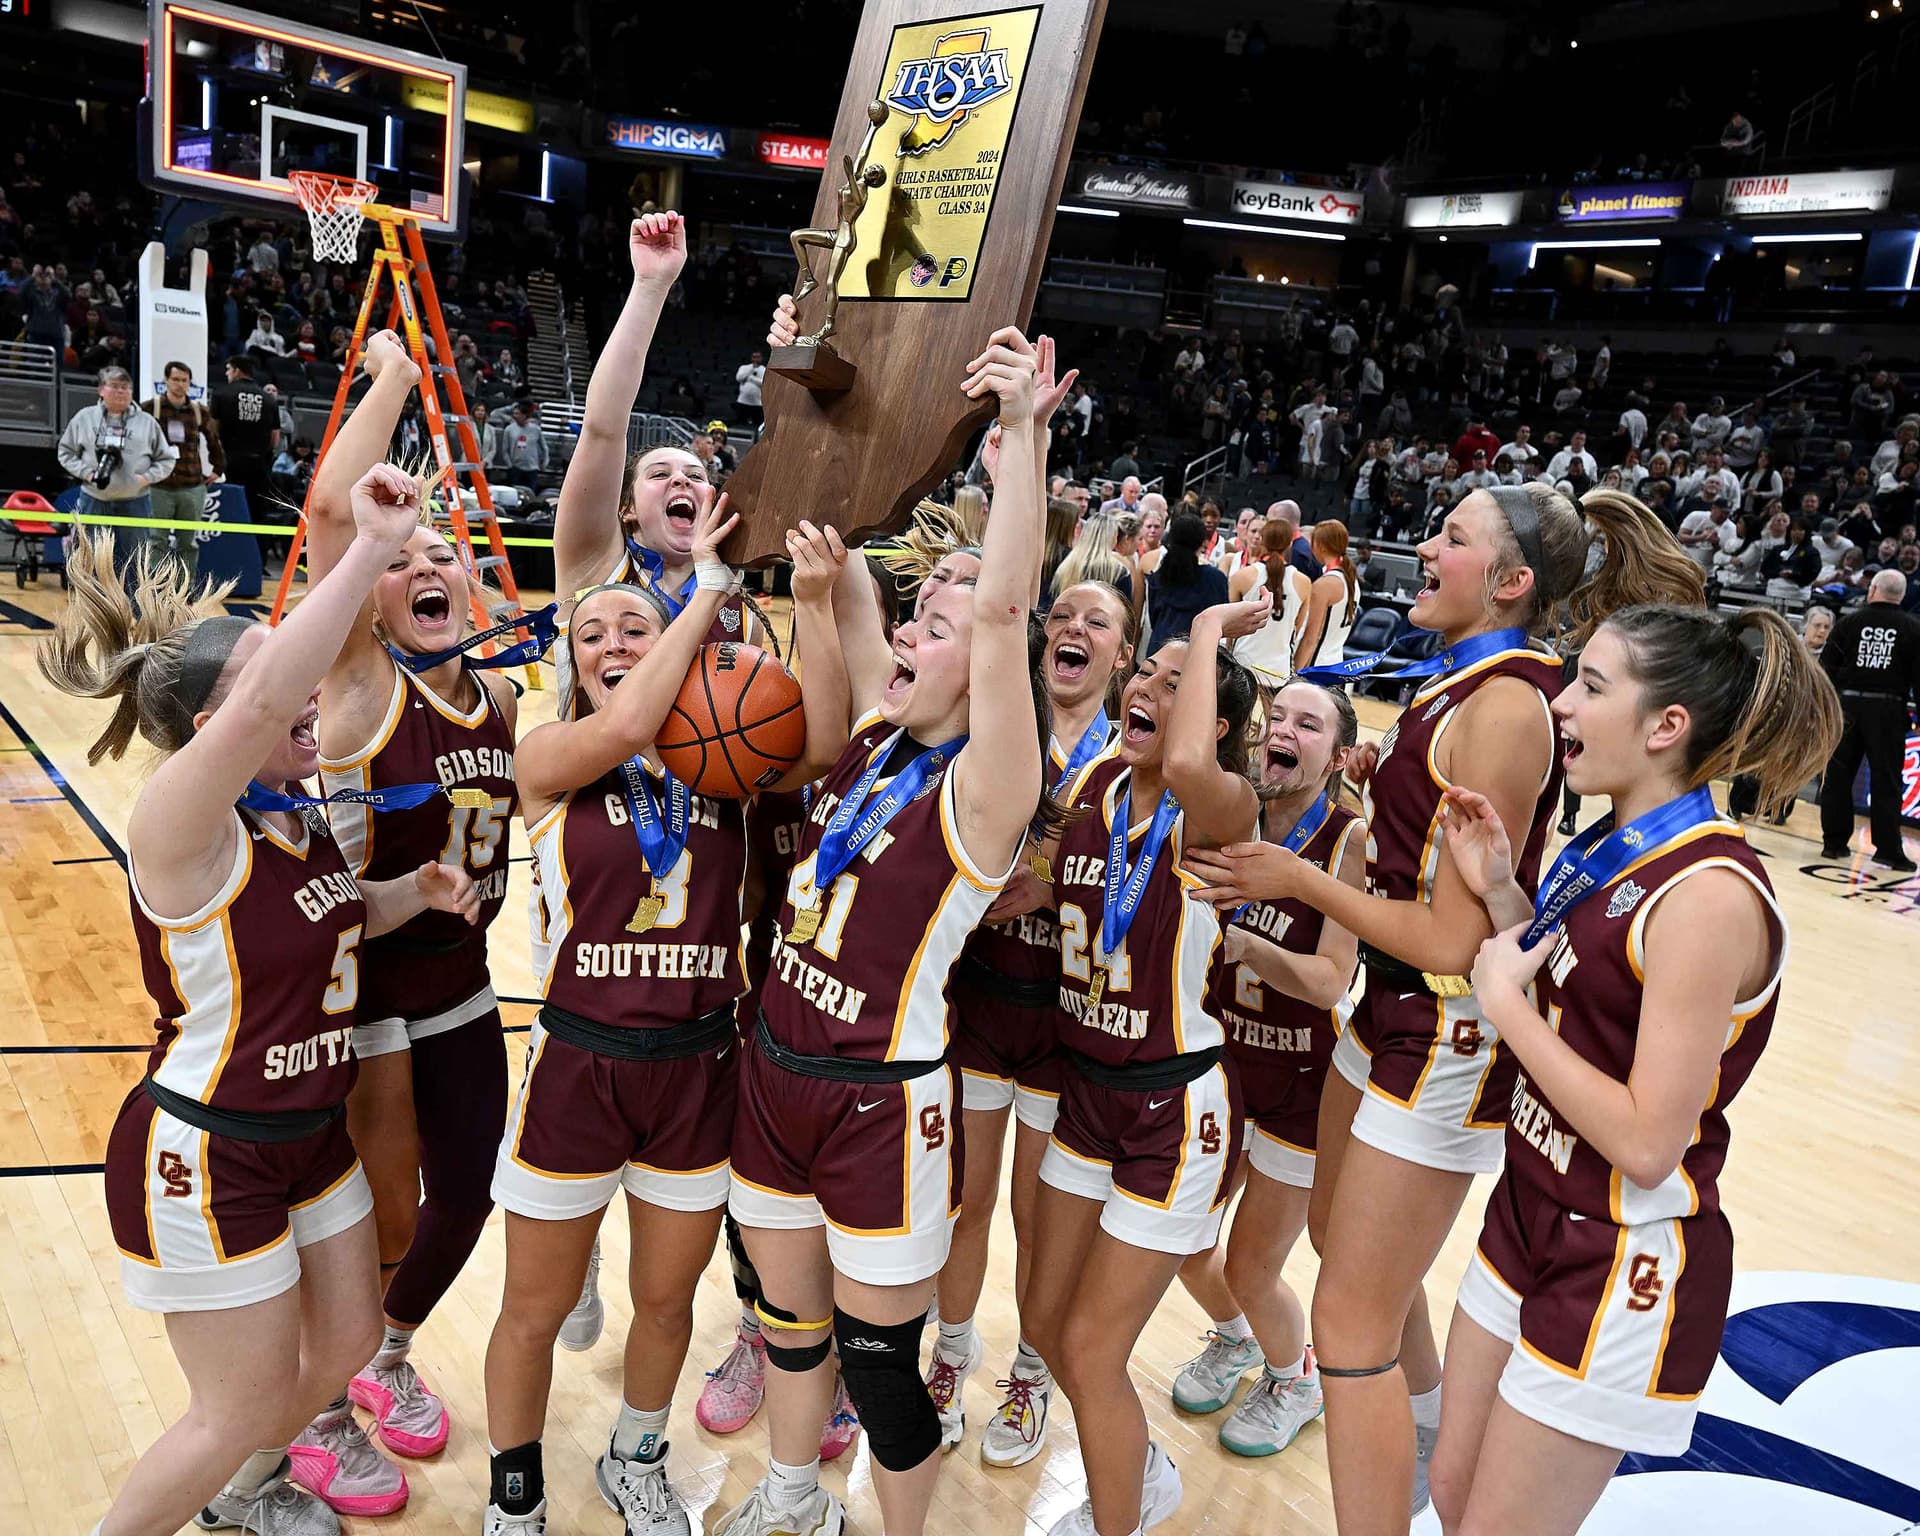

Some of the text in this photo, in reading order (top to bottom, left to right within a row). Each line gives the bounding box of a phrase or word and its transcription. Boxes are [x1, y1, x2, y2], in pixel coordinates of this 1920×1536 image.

[890, 54, 1008, 111] IHSAA
[607, 121, 725, 152] SHIPSIGMA
[762, 141, 811, 160] STEAK
[976, 150, 999, 163] 2024
[896, 167, 994, 184] GIRLS BASKETBALL
[902, 184, 991, 200] STATE CHAMPION
[1728, 177, 1789, 197] INDIANA
[938, 201, 985, 215] CLASS 3A
[1234, 189, 1315, 212] KeyBank
[1580, 194, 1684, 215] planet fitness
[1858, 640, 1894, 656] EVENT
[1861, 626, 1897, 642] CSC
[1856, 654, 1892, 669] STAFF
[623, 761, 653, 830] BASKETBALL
[671, 777, 685, 834] CHAMPION
[829, 767, 877, 835] BASKETBALL
[439, 797, 511, 868] 15
[846, 794, 898, 851] CHAMPION
[642, 847, 693, 928] 3
[1108, 835, 1123, 906] BASKETBALL
[1121, 854, 1153, 913] CHAMPION
[787, 849, 860, 961] 41
[1528, 871, 1596, 940] BASKETBALL
[321, 923, 363, 1016] 5
[575, 942, 728, 979] SOUTHERN
[1059, 901, 1132, 992] 24
